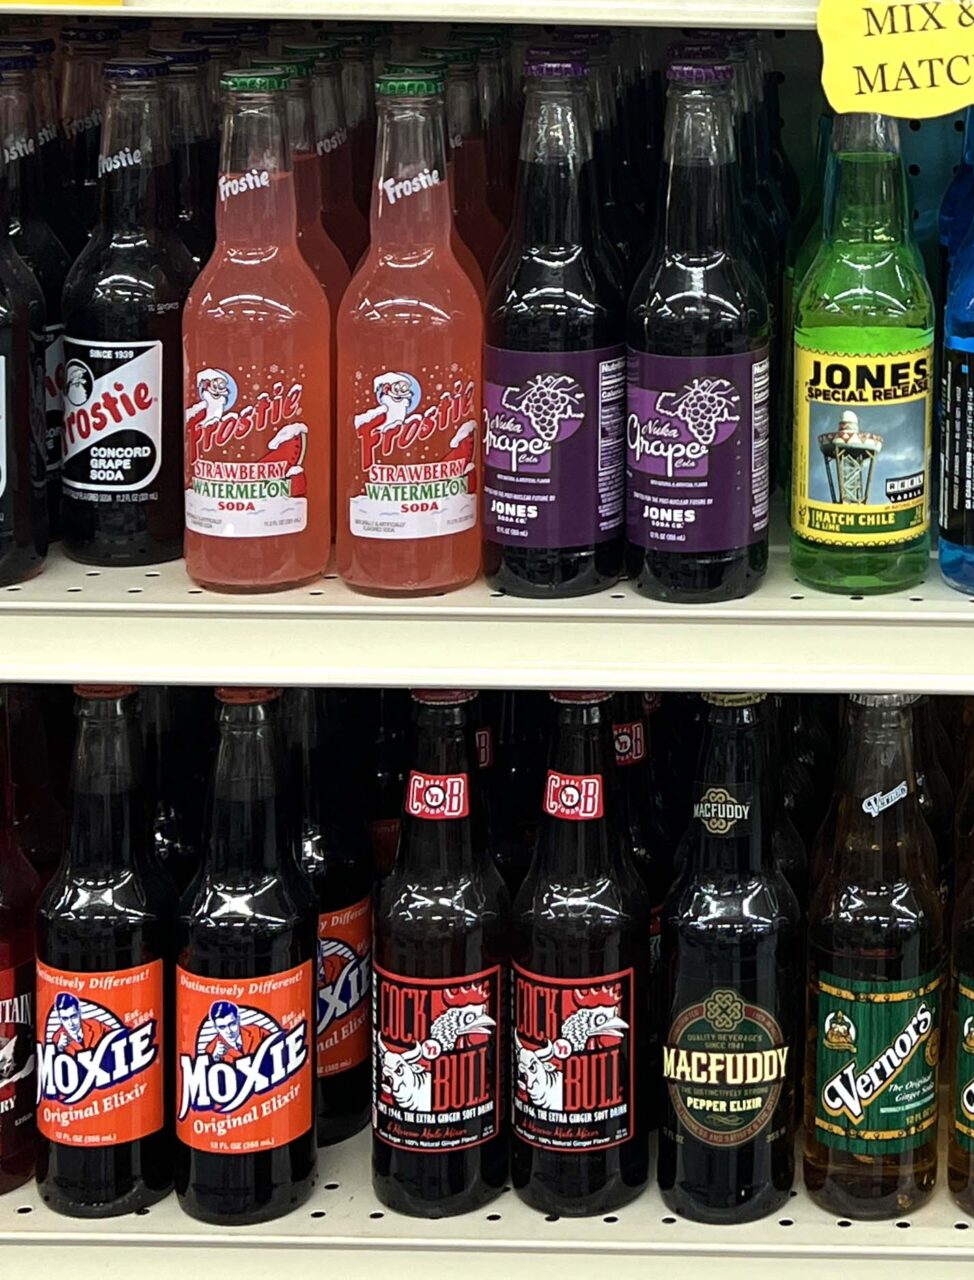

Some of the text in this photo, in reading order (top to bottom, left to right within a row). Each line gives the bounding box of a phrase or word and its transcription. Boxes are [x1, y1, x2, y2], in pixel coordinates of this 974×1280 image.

[863, 1, 947, 37] MIX
[218, 169, 270, 202] Frostie
[383, 168, 440, 205] Frostie
[808, 358, 929, 389] JONES
[807, 380, 929, 402] SPECIAL RELEASE
[490, 414, 523, 433] Nuka
[642, 420, 679, 439] Nuka
[90, 446, 151, 458] CONCORD
[90, 458, 131, 470] GRAPE
[194, 463, 288, 482] STRAWBERRY
[369, 460, 466, 482] STRAWBERRY
[90, 470, 124, 481] SODA
[192, 480, 291, 500] WATERMELON
[367, 480, 469, 501] WATERMELON
[217, 503, 255, 512] SODA
[401, 503, 439, 513] SODA
[490, 500, 538, 518] JONES
[643, 505, 696, 522] JONES
[815, 511, 896, 525] HATCH CHILE
[90, 970, 149, 990] Different!
[180, 970, 303, 998] Distinctively Different!
[380, 981, 428, 1041] COCK
[516, 980, 559, 1041] COCK
[36, 1022, 156, 1105] MOXIE
[663, 1046, 790, 1085] MACFUDDY
[823, 1003, 933, 1118] Vernors
[177, 1024, 309, 1122] MOXIE
[433, 1048, 489, 1111] BULL
[564, 1049, 622, 1111] BULL
[44, 1082, 147, 1126] Original Elixir
[193, 1084, 301, 1136] Original Elixir
[404, 1100, 494, 1124] THE EXTRA GINGER SOFT DRINK
[687, 1096, 763, 1112] PEPPER ELIXIR
